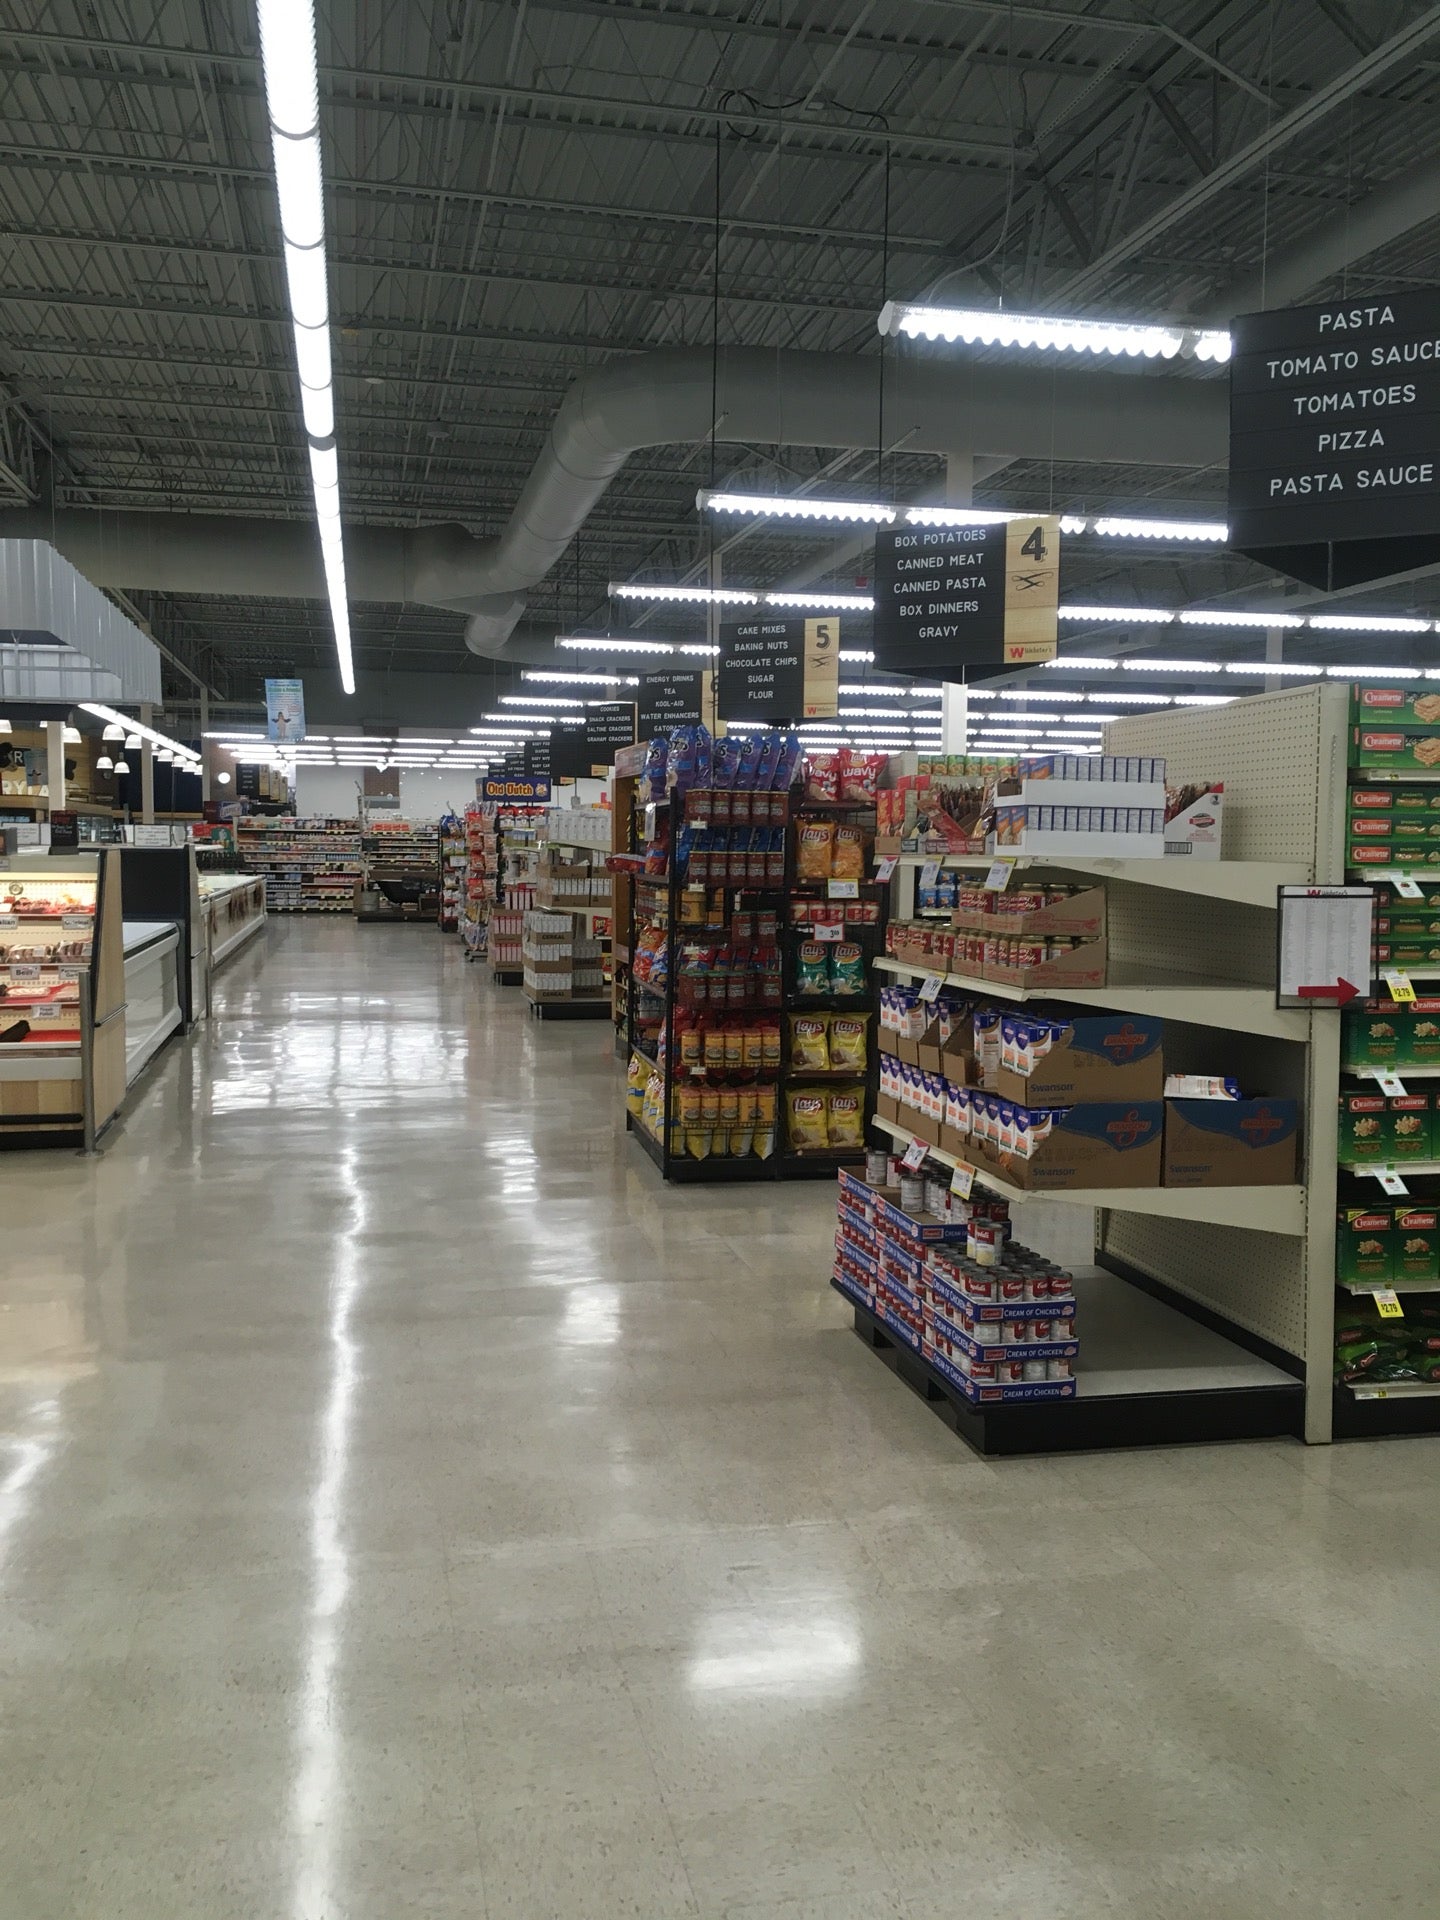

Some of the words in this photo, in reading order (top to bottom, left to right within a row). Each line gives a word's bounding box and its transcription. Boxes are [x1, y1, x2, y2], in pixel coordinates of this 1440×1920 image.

[1319, 306, 1395, 332] PASTA
[1267, 351, 1359, 379] TOMATO
[1294, 384, 1416, 415] TOMATOES
[1318, 429, 1384, 452] PIZZA
[1270, 473, 1344, 496] PASTA
[1357, 464, 1433, 488] SAUCE
[895, 536, 917, 548] BOX
[924, 529, 986, 544] POTATOES
[1021, 526, 1047, 562] 4
[897, 556, 944, 571] CANNED
[950, 553, 984, 567] MEAT
[894, 579, 941, 594] CANNED
[946, 577, 986, 590] PASTA
[900, 604, 922, 617] BOX
[928, 601, 979, 615] DINNERS
[737, 627, 758, 635] CAKE
[761, 625, 786, 634] MIXES
[816, 625, 831, 649] 5
[918, 626, 958, 638] GRAVY
[734, 642, 763, 652] BAKING
[767, 641, 788, 650] NUTS
[725, 658, 771, 668] CHOCOLATE
[775, 657, 797, 666] CHIPS
[646, 675, 670, 683] ENERGY
[747, 674, 774, 683] SUGAR
[748, 690, 773, 699] FLOUR
[655, 700, 684, 708] KOOL-AID
[487, 781, 505, 796] Old
[505, 782, 534, 796] Dutch
[1004, 1309, 1024, 1317] CREAM
[1035, 1308, 1060, 1316] CHICKEN
[1007, 1350, 1027, 1358] CREAM
[1003, 1390, 1024, 1398] CREAM
[1034, 1388, 1059, 1396] CHICKEN
